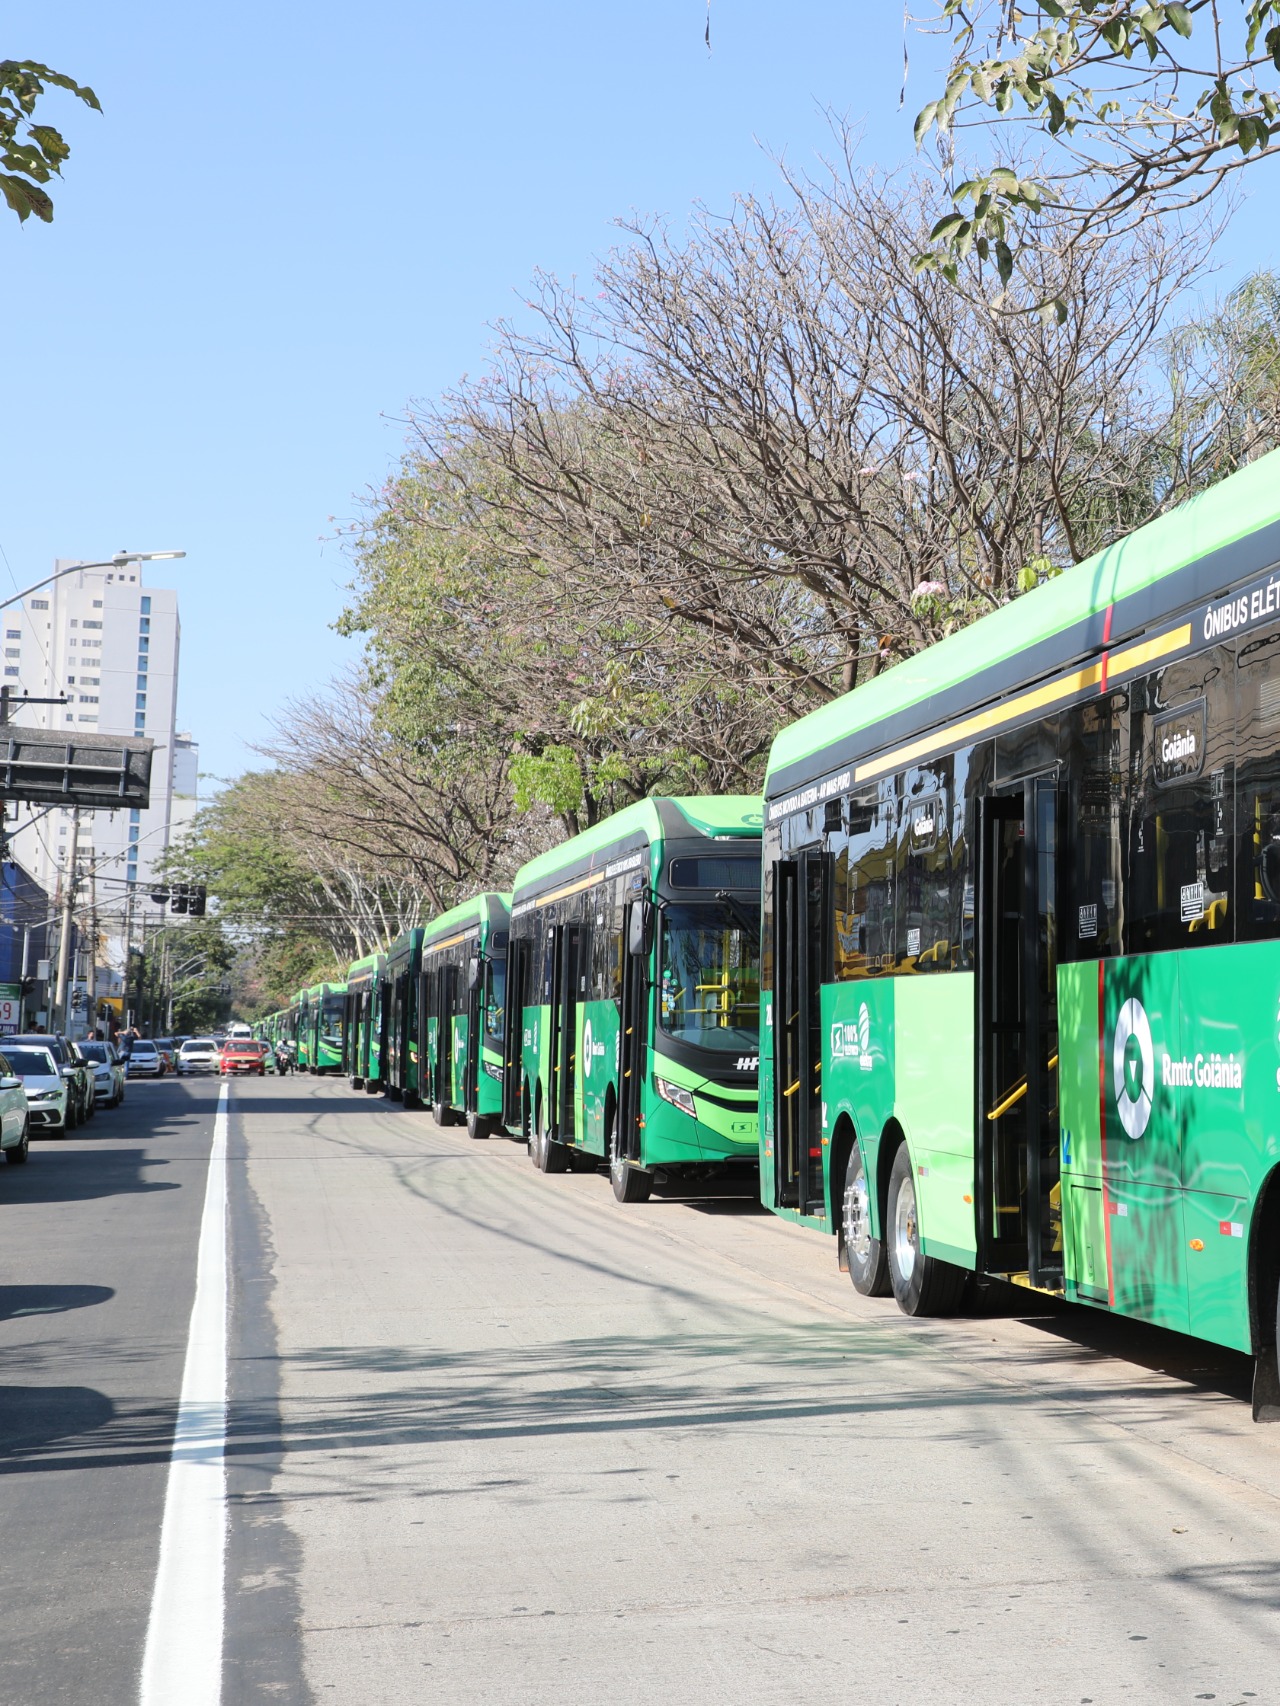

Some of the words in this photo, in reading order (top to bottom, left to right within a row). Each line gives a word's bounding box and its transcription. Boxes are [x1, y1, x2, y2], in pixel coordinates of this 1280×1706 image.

[1203, 596, 1248, 640] ÔNIBUS
[1162, 730, 1196, 763] Goiânia
[1162, 1053, 1194, 1087] Rmtc
[1194, 1053, 1242, 1089] Goiânia
